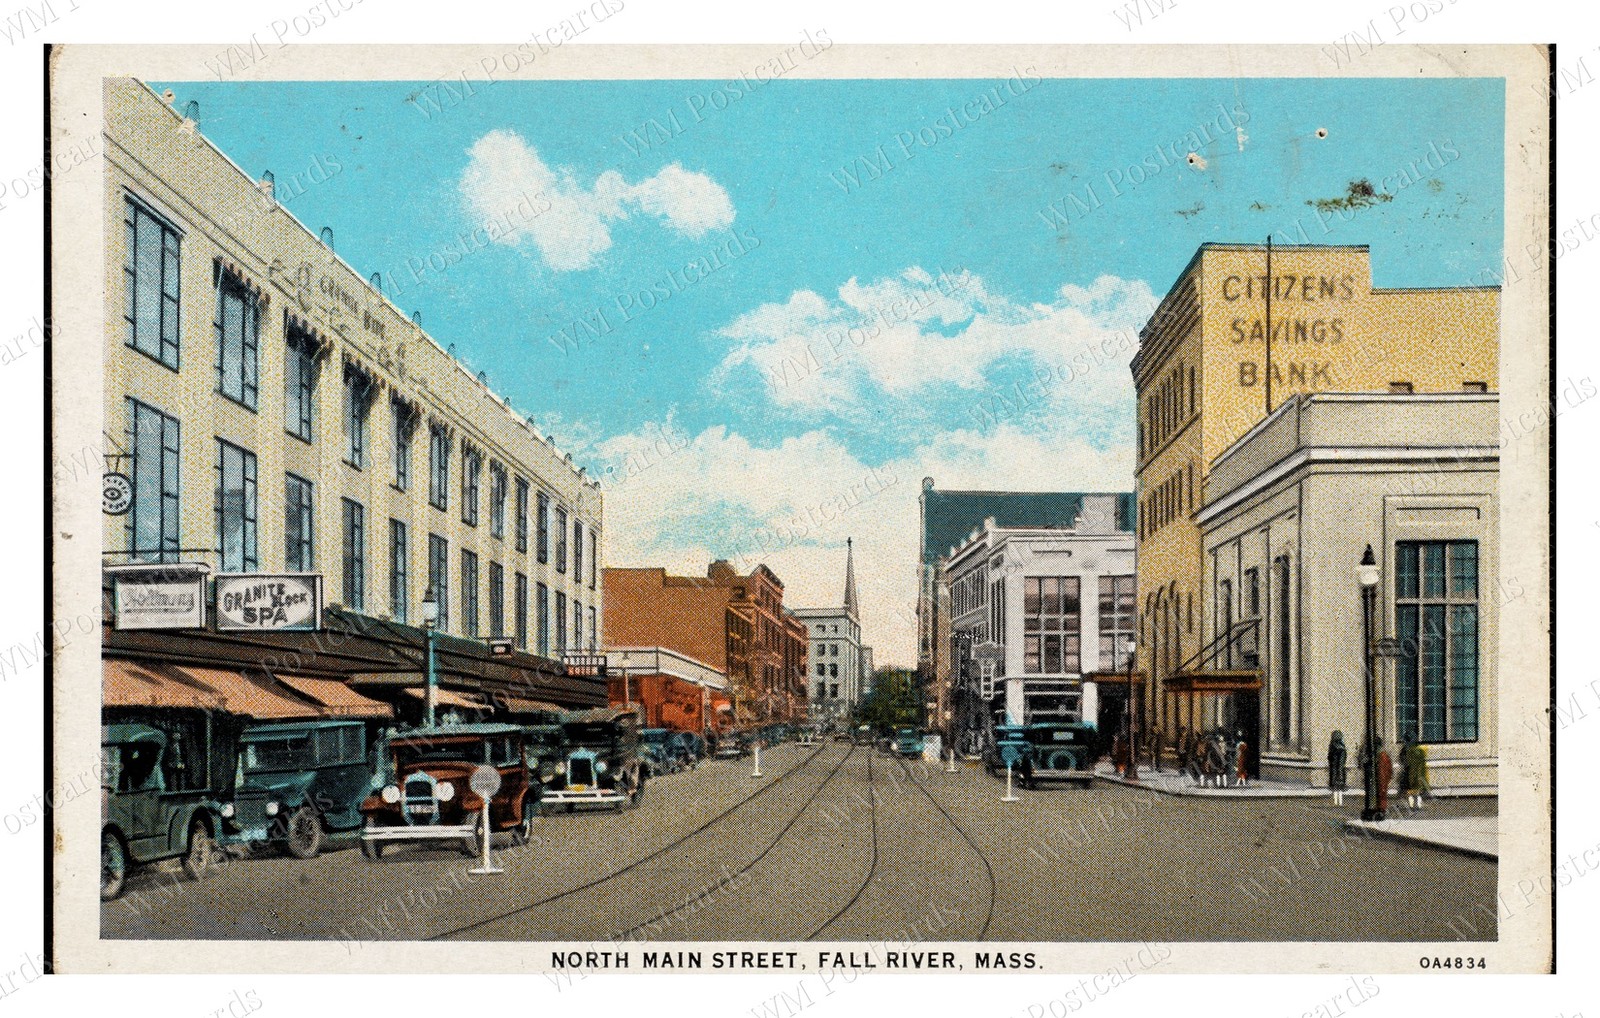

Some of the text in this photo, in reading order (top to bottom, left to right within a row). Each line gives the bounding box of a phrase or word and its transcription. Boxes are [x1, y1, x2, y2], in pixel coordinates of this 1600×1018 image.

[1222, 275, 1354, 301] CITIZENS
[1231, 318, 1342, 344] SAVINGS
[1239, 361, 1332, 387] BANK
[223, 583, 286, 612] GRANITE
[271, 591, 308, 608] BLOCK
[243, 606, 288, 626] SPA
